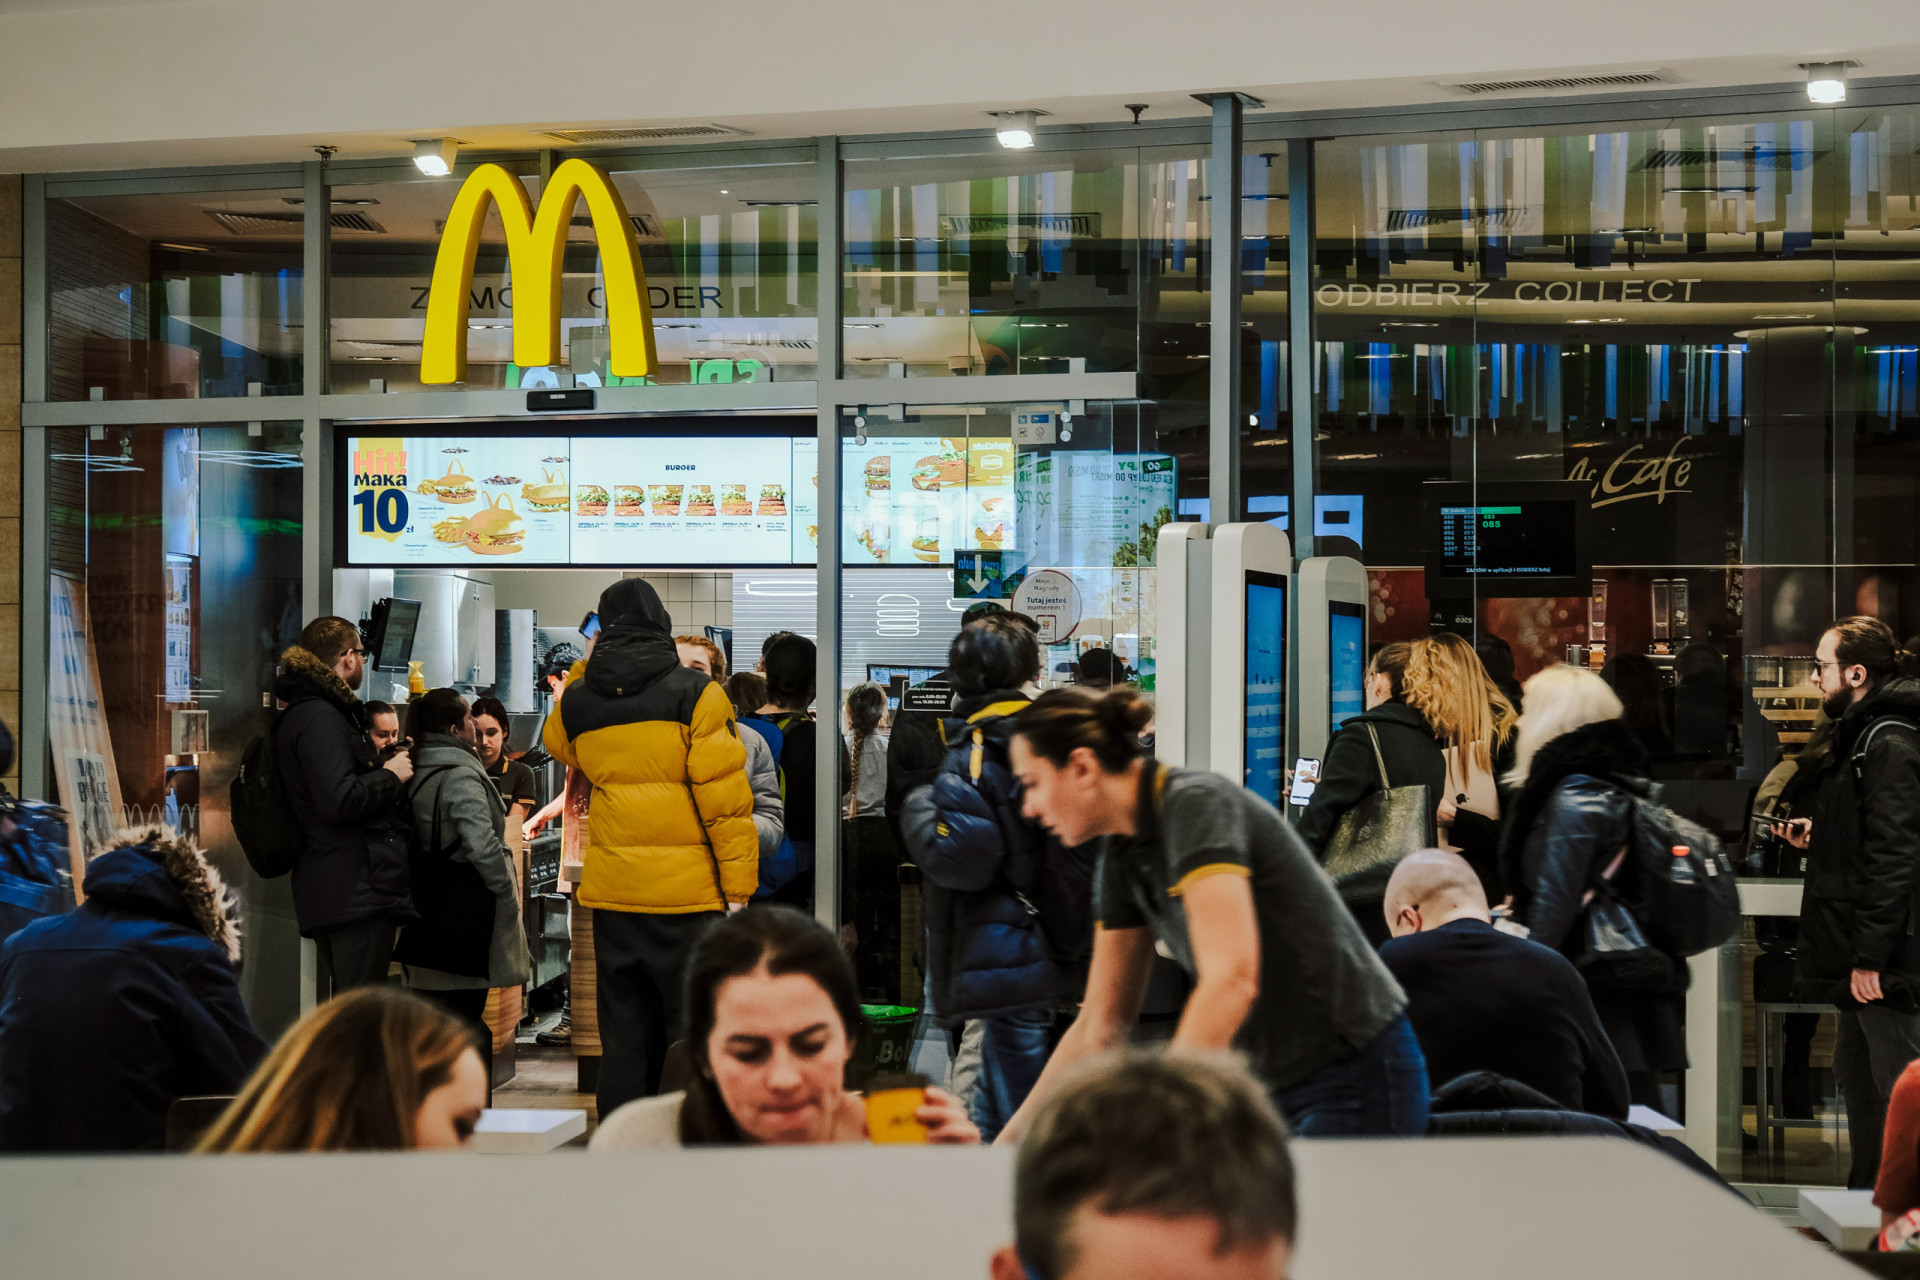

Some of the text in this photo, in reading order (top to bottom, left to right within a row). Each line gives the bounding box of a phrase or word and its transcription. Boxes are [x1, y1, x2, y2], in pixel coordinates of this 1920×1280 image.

[1316, 278, 1702, 308] ODBIERZ COLLECT
[973, 442, 1011, 452] McCrispy
[353, 448, 407, 475] Hit!
[353, 473, 407, 487] Maka
[353, 488, 415, 534] 10 zł
[1482, 520, 1501, 529] 085
[1026, 596, 1044, 605] Tutaj
